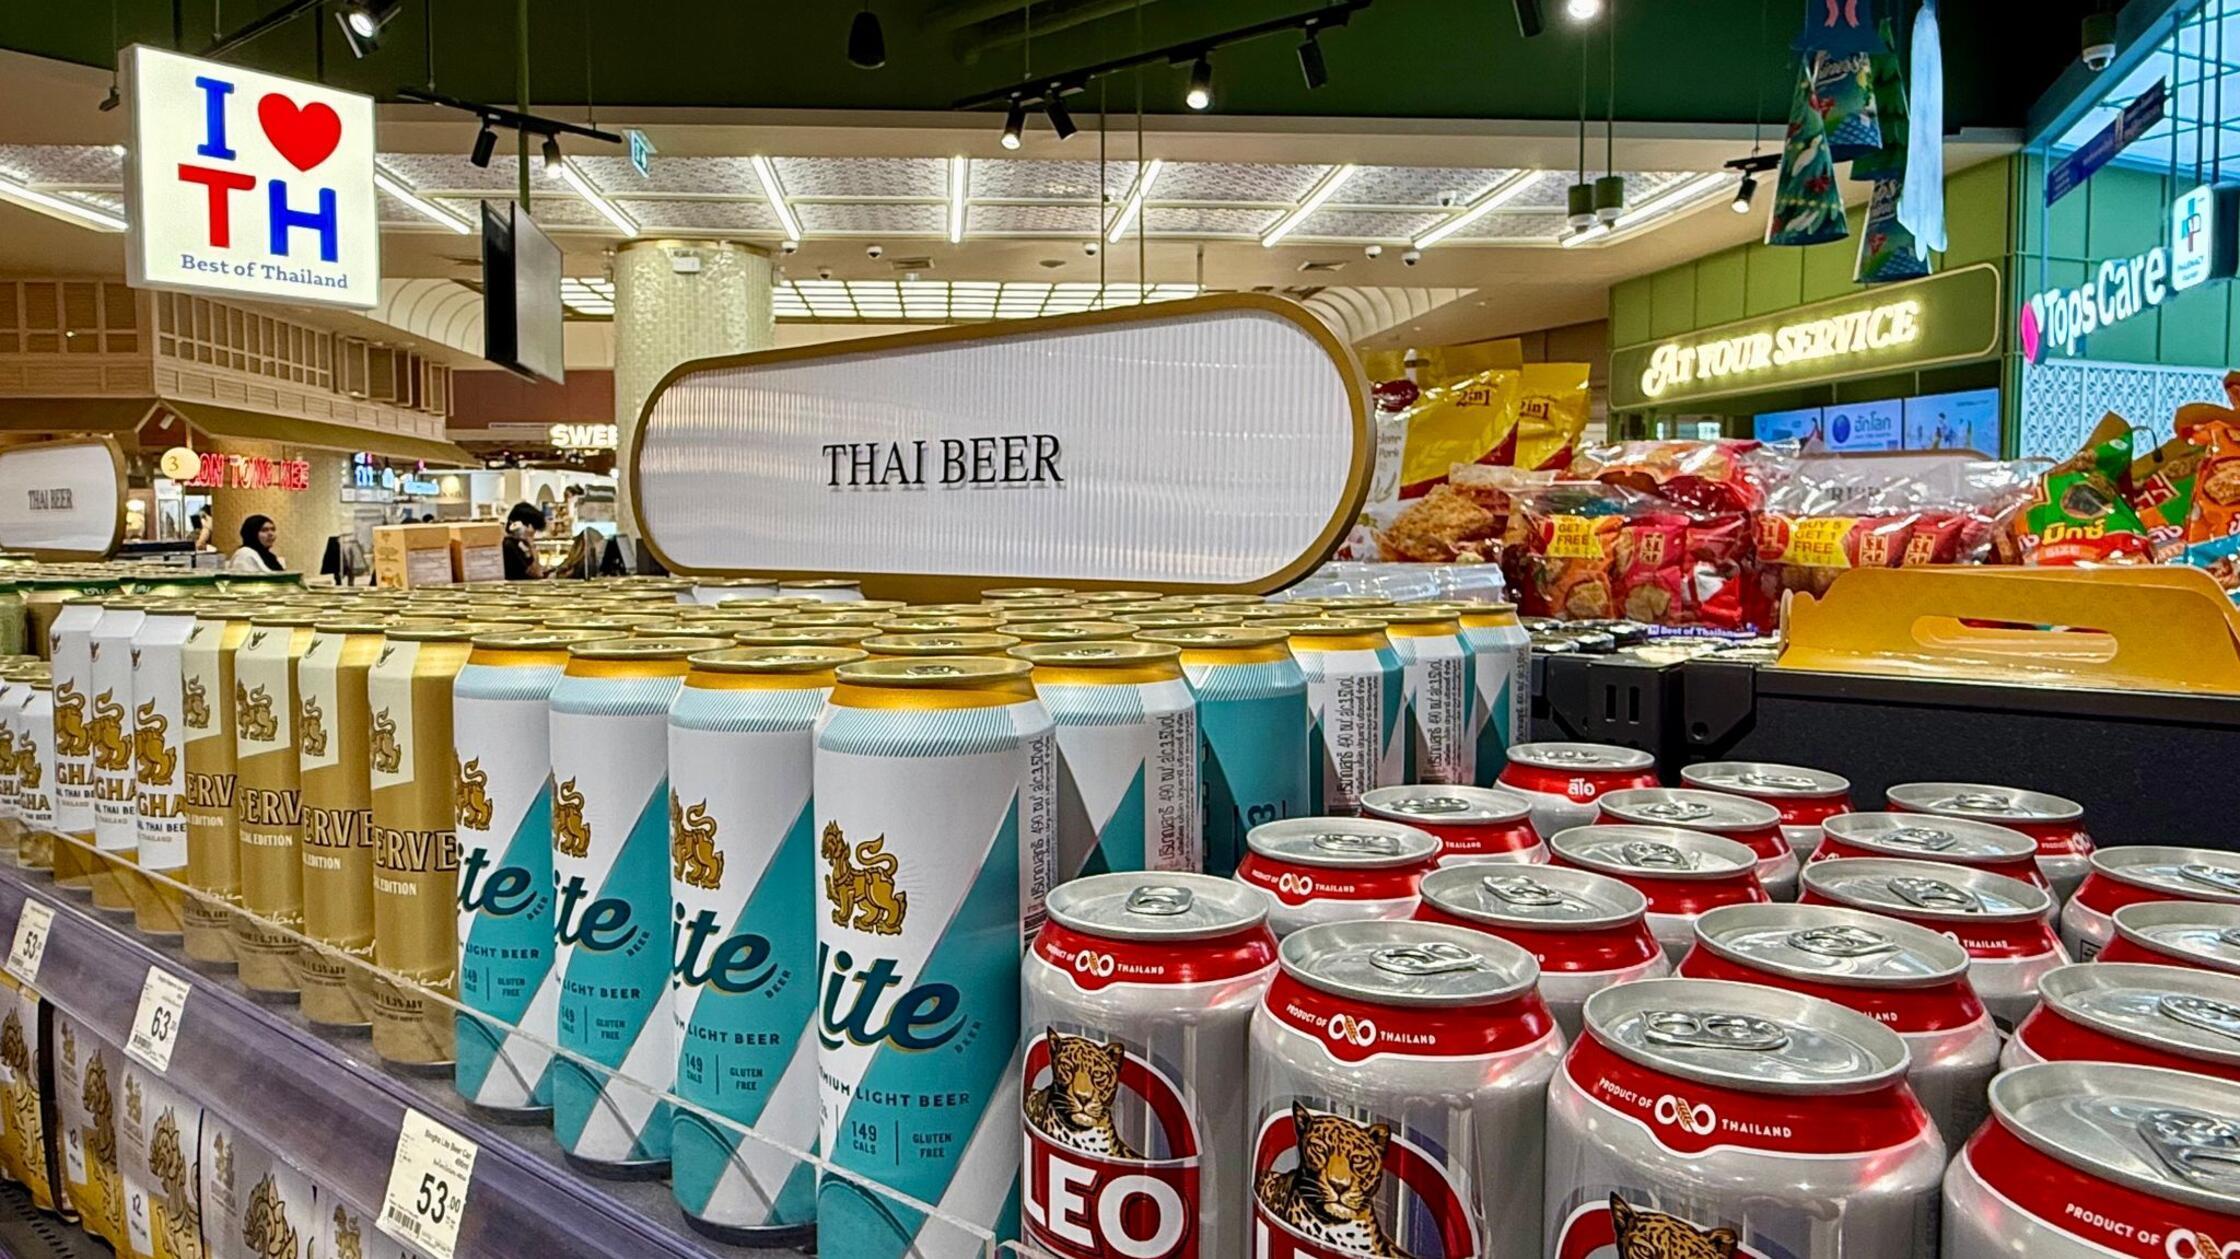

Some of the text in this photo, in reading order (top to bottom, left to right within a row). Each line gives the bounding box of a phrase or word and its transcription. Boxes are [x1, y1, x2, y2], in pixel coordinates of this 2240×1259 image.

[196, 76, 237, 161] I
[181, 254, 348, 289] Best of Thailand
[1696, 333, 1773, 380] YOUR
[1773, 300, 1920, 366] SERVICE
[168, 455, 179, 471] 3
[822, 434, 1065, 487] THAI BEER
[28, 488, 73, 510] THAI BEER
[1559, 523, 1580, 533] GET
[1795, 530, 1822, 540] GET
[1557, 535, 1590, 545] FREE
[1794, 541, 1834, 554] FREE
[1661, 627, 1681, 635] Best
[1683, 627, 1694, 635] of
[253, 834, 293, 846] EDITION
[1445, 840, 1482, 849] THAILAND
[1314, 883, 1356, 893] THAILAND
[22, 931, 38, 959] 53
[466, 942, 540, 960] LIGHT BEER
[626, 930, 650, 957] BEER
[1963, 939, 2008, 949] THAILAND
[1117, 963, 1165, 975] THAILAND
[564, 981, 641, 1000] LIGHT BEER
[764, 969, 792, 999] BEER
[151, 1006, 172, 1042] 63
[1286, 1003, 1436, 1045] PRODUCT OF THAILAND
[688, 1026, 780, 1045] LIGHT BEER
[954, 1020, 982, 1055] BEER
[685, 1052, 703, 1073] 149
[730, 1066, 763, 1078] GLUTEN
[736, 1080, 757, 1091] FREE
[856, 1087, 912, 1108] LIGHT
[919, 1092, 971, 1108] BEER
[1599, 1076, 1792, 1138] PRODUCT OF THAILAND
[851, 1120, 878, 1143] 149
[912, 1132, 953, 1146] GLUTEN
[853, 1140, 877, 1156] CALS
[920, 1146, 946, 1159] FREE
[416, 1172, 449, 1224] 53
[1024, 1128, 1185, 1258] LEO
[2065, 1203, 2161, 1246] PRODUCT OF
